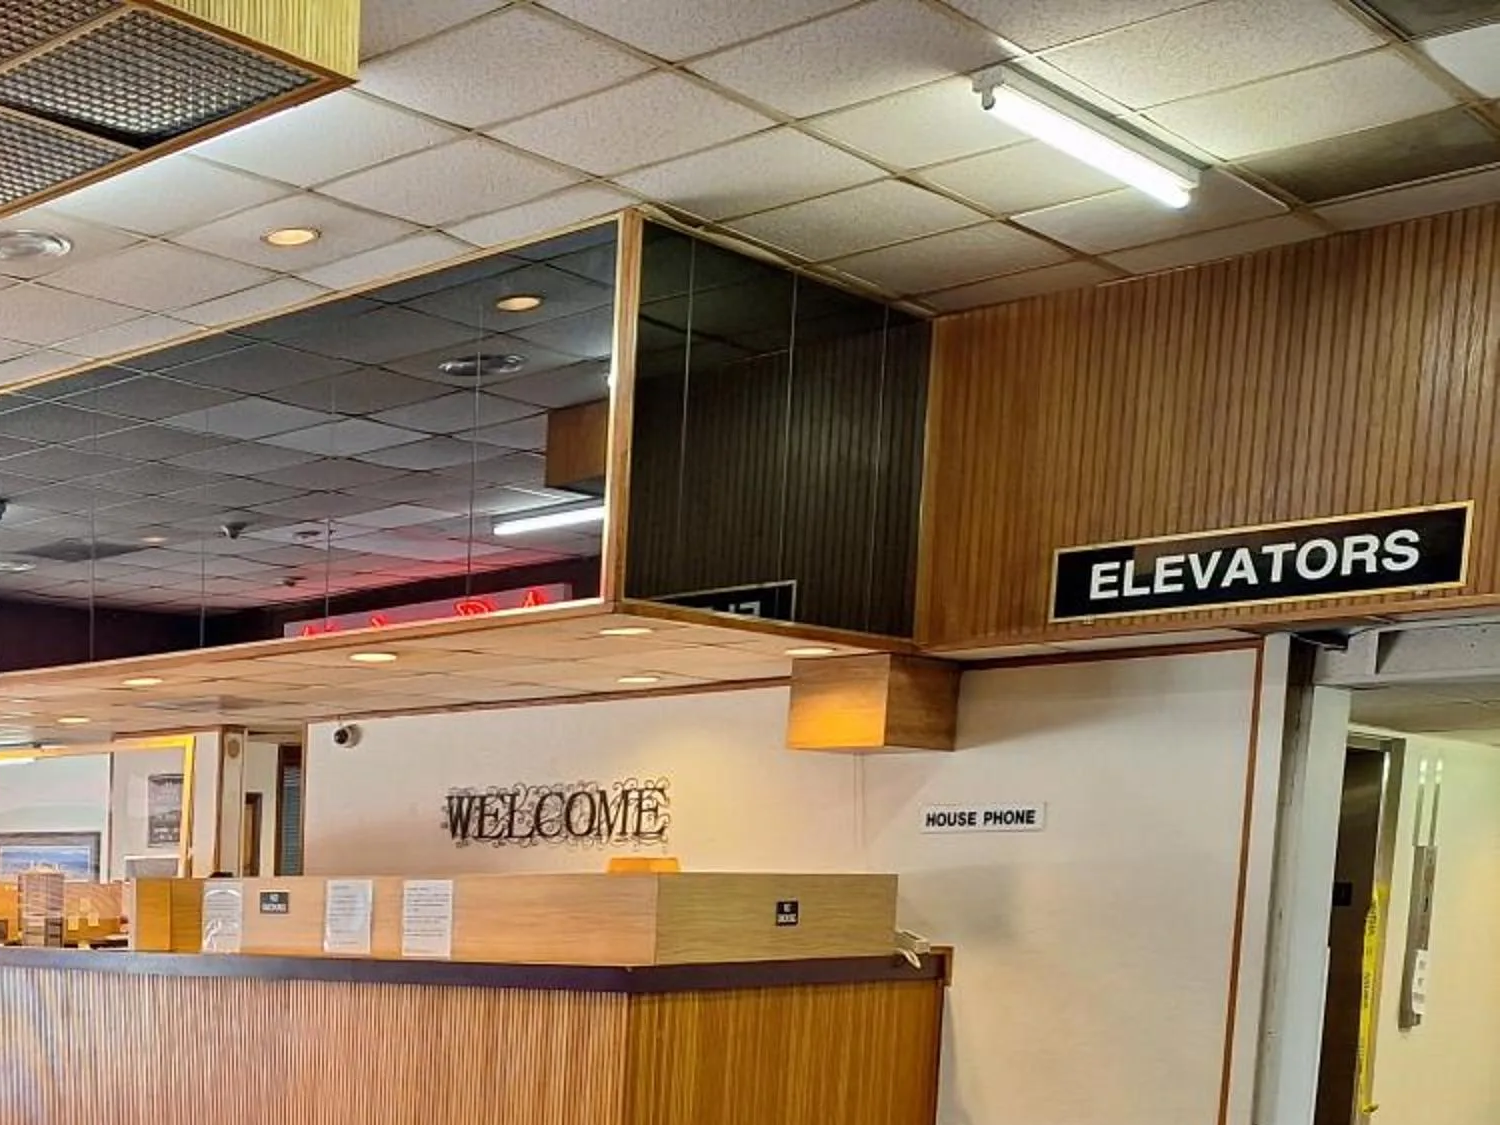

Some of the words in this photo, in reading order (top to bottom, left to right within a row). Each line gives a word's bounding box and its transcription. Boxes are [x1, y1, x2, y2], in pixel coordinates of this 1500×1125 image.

[1089, 528, 1421, 601] ELEVATORS
[444, 780, 669, 843] WELCOME
[925, 810, 978, 828] HOUSE
[982, 809, 1037, 827] PHONE
